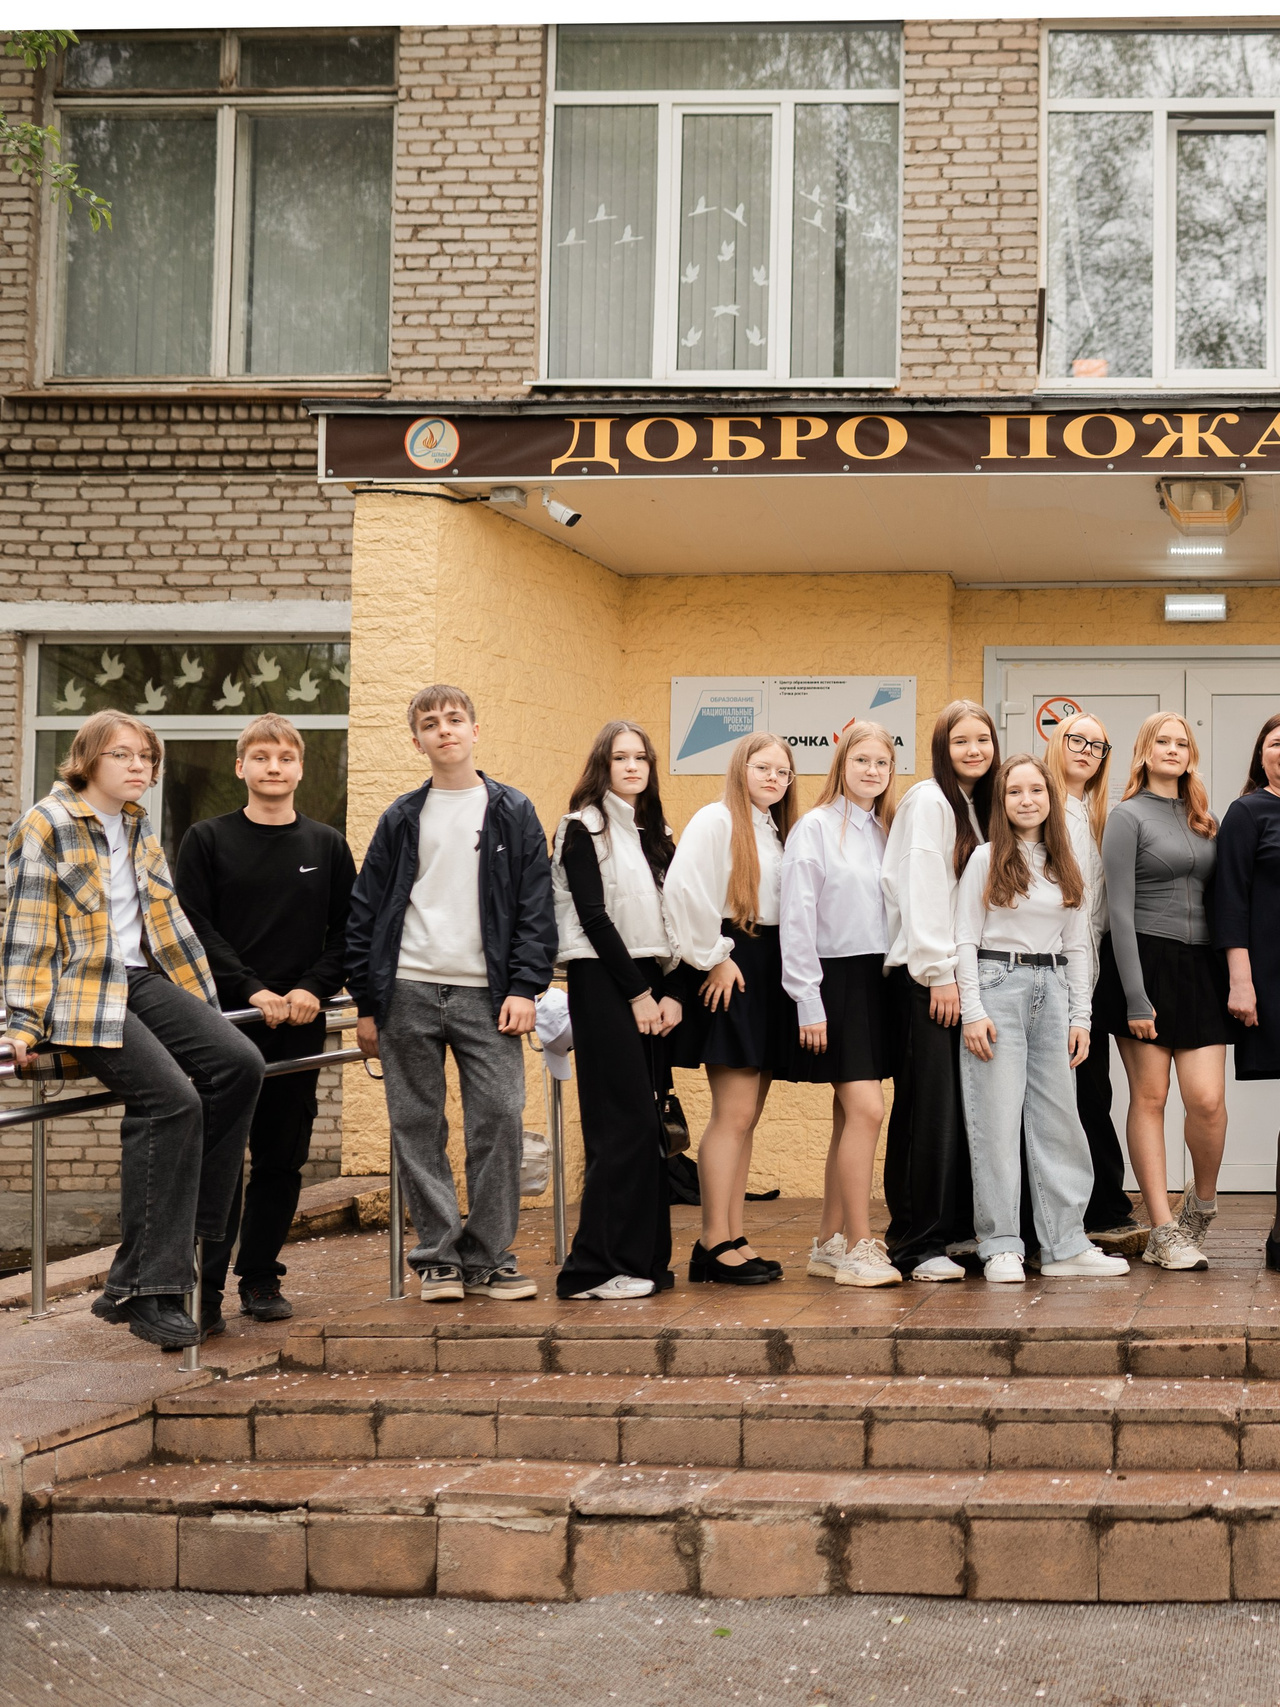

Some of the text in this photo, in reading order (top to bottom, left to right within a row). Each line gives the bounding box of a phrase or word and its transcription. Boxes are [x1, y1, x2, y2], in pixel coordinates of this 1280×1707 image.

[551, 414, 908, 474] ДОБРО
[701, 708, 753, 717] НАЦИОНАЛЬНЫЕ
[723, 716, 753, 724] ПРОЕКТЫ
[728, 724, 753, 732] РОССИИ
